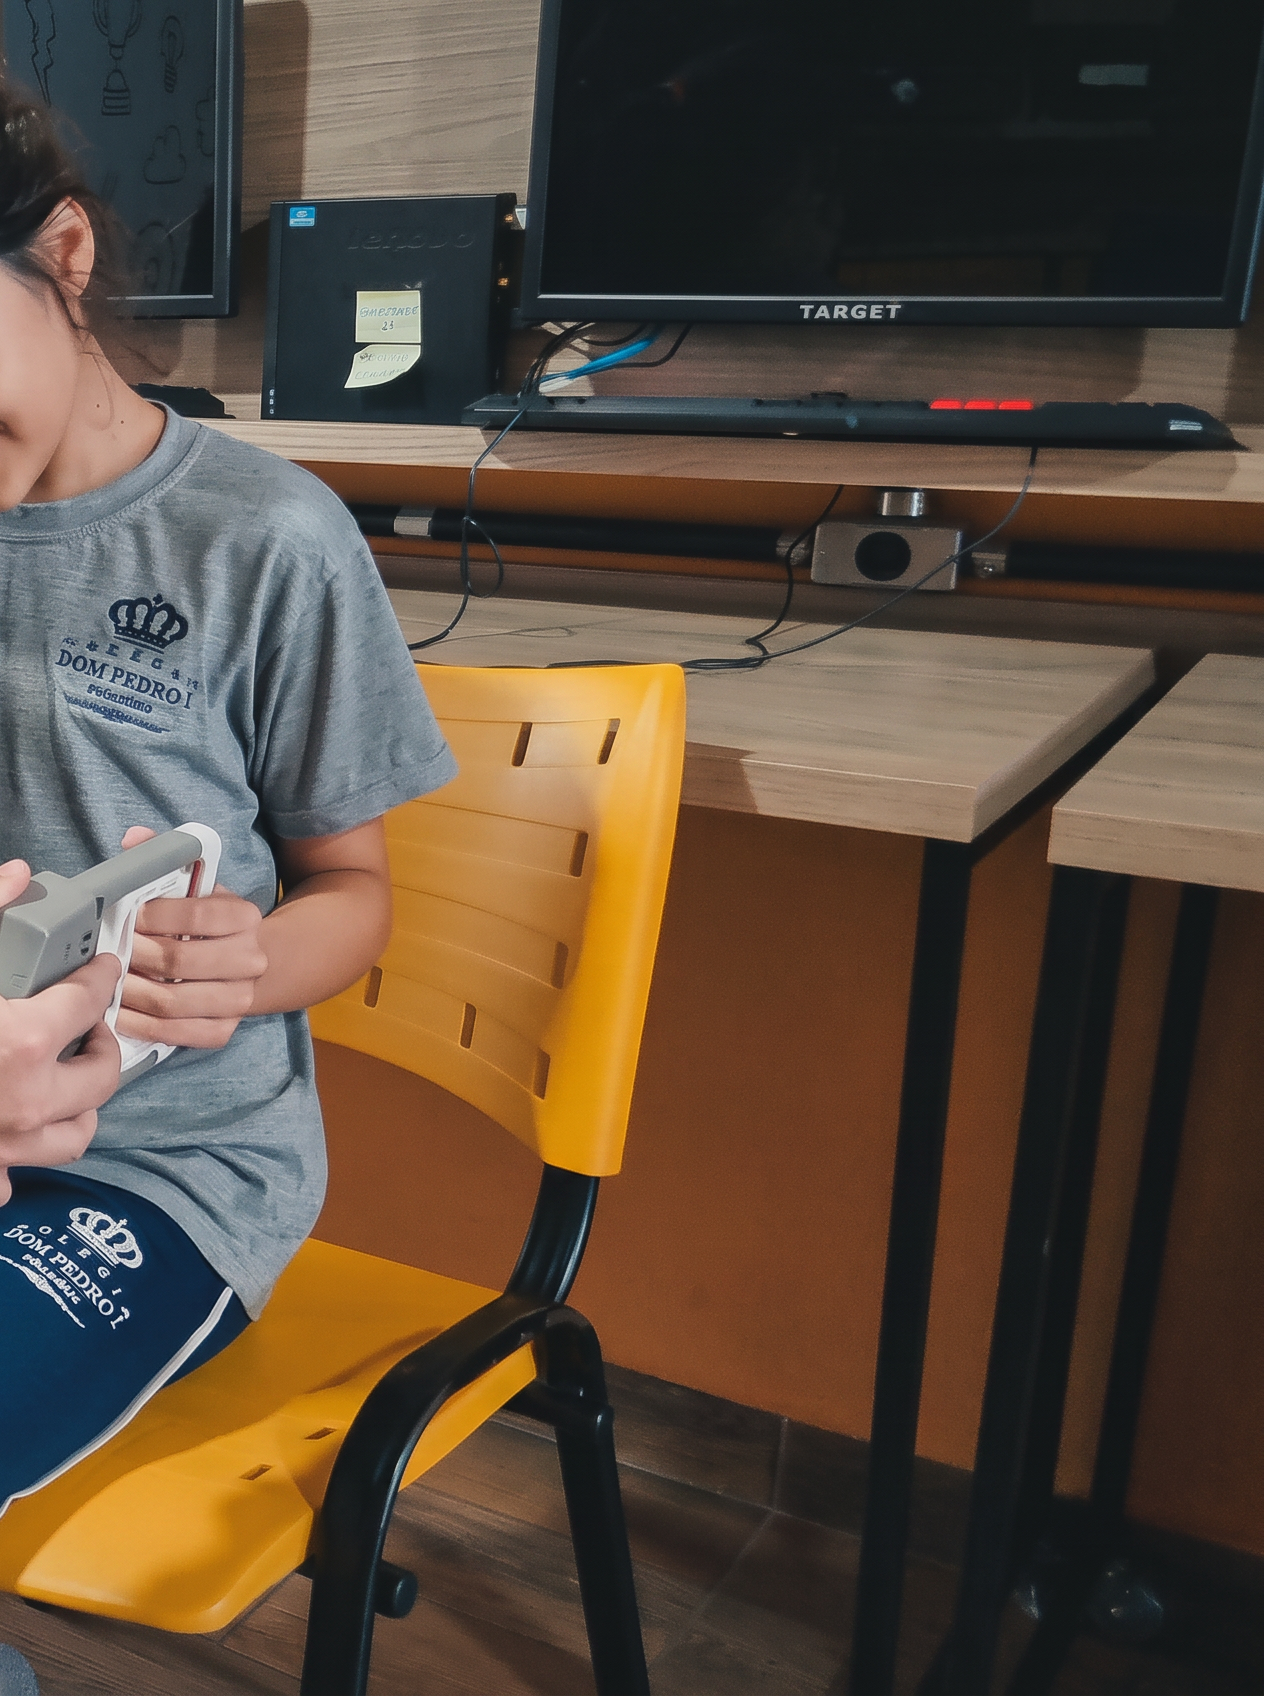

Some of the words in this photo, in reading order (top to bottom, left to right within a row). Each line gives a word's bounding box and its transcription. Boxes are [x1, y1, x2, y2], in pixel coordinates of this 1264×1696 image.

[799, 304, 902, 319] TARGET
[55, 648, 109, 680] DOM
[109, 666, 182, 706] PEDRO
[183, 691, 193, 710] I
[3, 1227, 54, 1257] DOM
[49, 1251, 114, 1315] PEDRO
